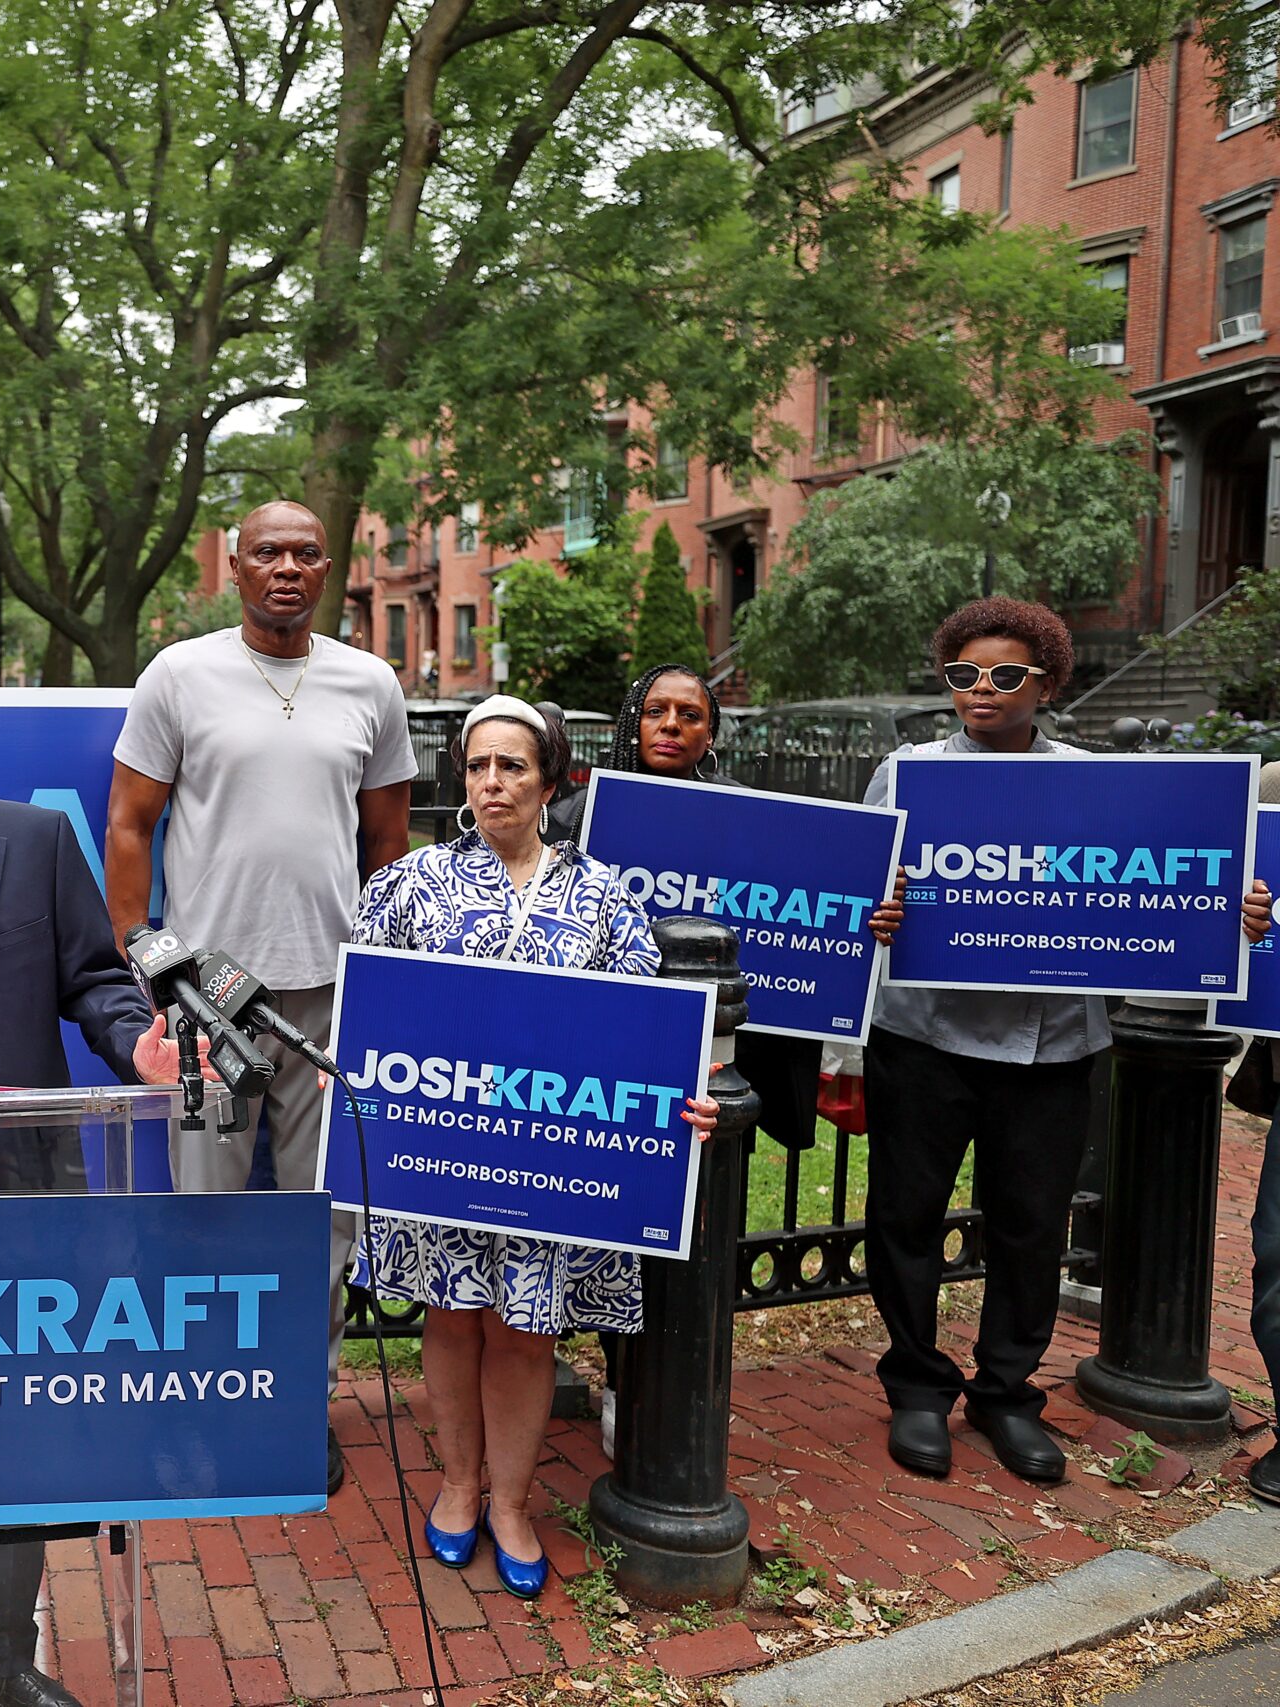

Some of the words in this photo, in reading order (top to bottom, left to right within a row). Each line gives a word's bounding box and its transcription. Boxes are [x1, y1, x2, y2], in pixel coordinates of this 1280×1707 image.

[906, 891, 937, 901] 2025
[946, 888, 1078, 907] DEMOCRAT
[1085, 892, 1132, 909] FOR
[1139, 893, 1228, 912] MAYOR
[148, 949, 182, 967] BOSTON
[150, 935, 179, 957] 10
[745, 927, 785, 948] FOR
[790, 933, 864, 958] MAYOR
[948, 932, 1176, 954] JOSHFORBOSTON.COM
[203, 963, 233, 992] YOUR
[208, 967, 241, 1001] LOCAL
[216, 973, 250, 1009] STATION
[386, 1102, 524, 1138] DEMOCRAT
[530, 1122, 578, 1145] FOR
[585, 1129, 676, 1158] MAYOR
[387, 1153, 620, 1200] JOSHFORBOSTON.COM
[24, 1373, 106, 1406] FOR
[122, 1369, 274, 1403] MAYOR
